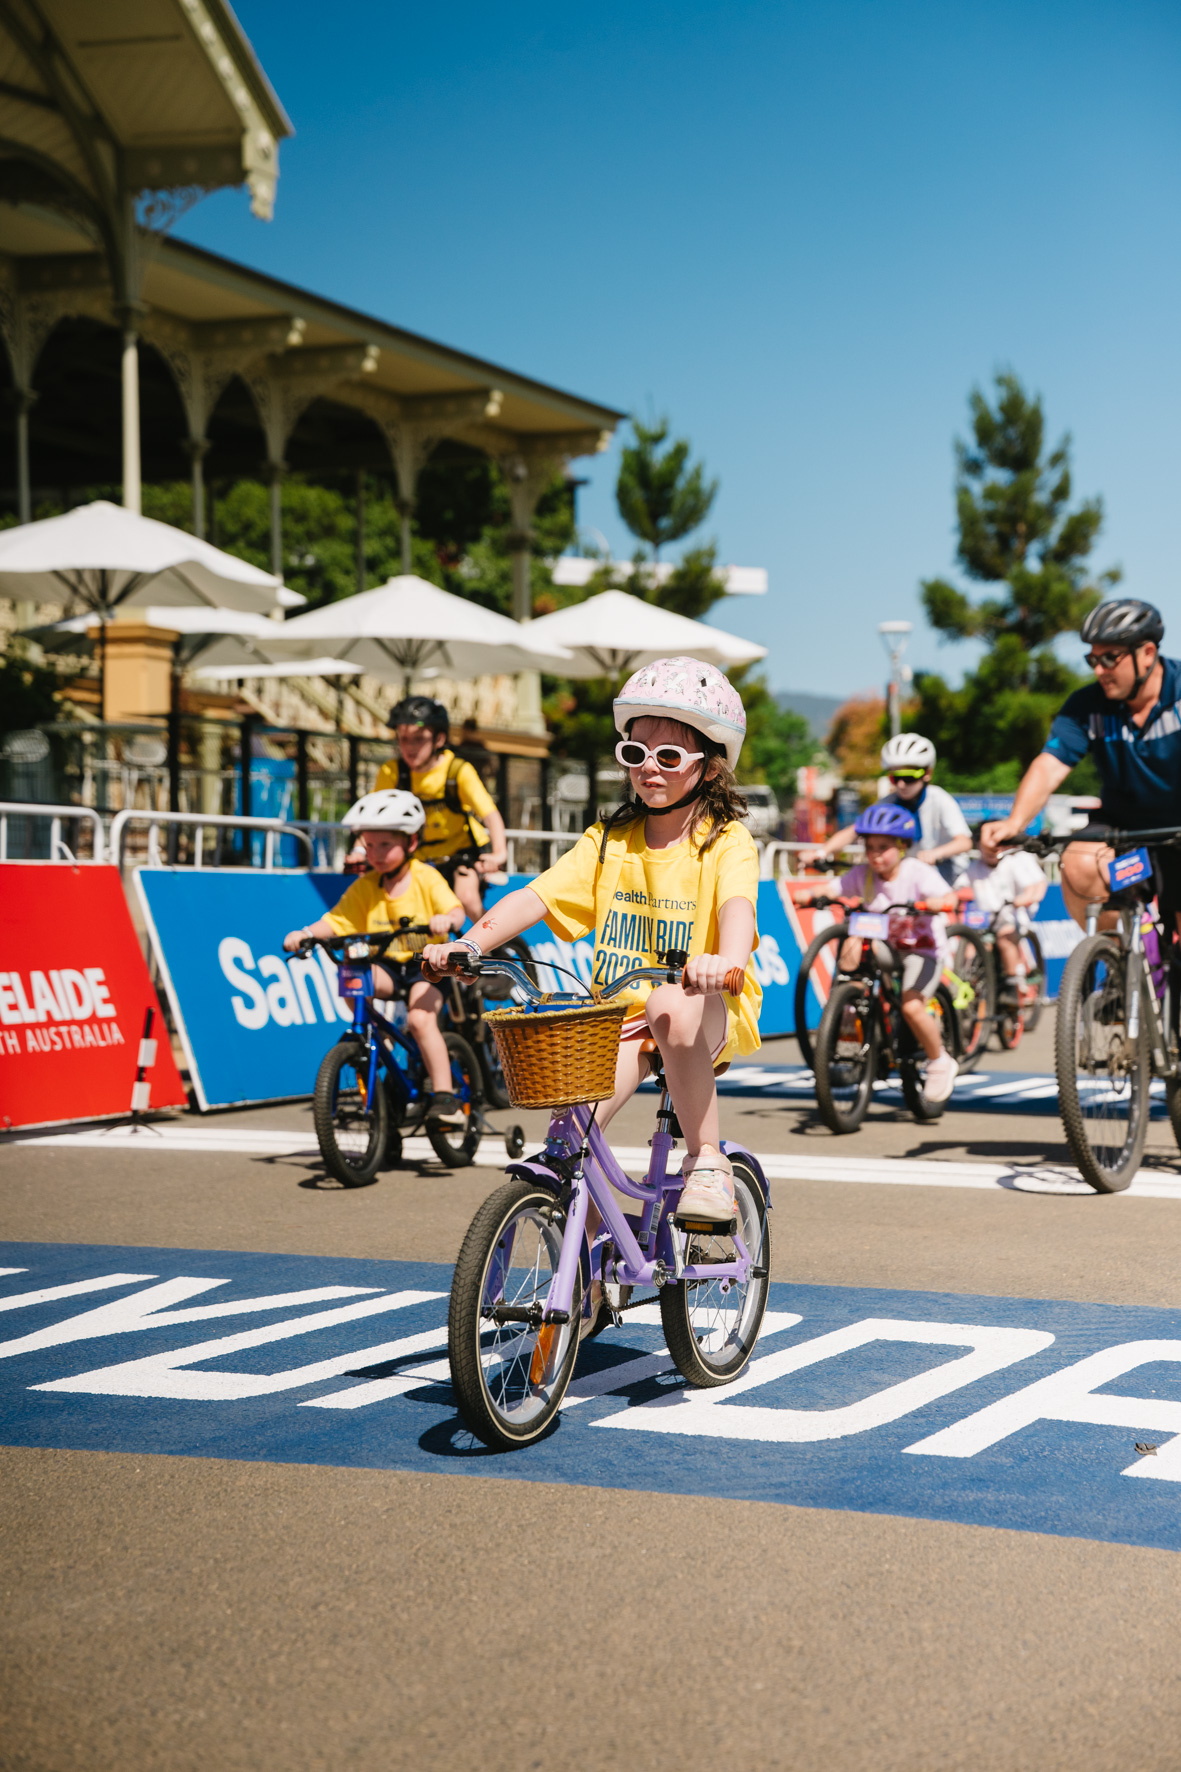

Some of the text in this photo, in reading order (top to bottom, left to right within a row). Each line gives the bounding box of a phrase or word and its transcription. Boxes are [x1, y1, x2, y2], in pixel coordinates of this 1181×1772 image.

[613, 889, 697, 911] ealthPartners
[599, 909, 695, 957] FAMILY RIDE
[0, 967, 117, 1025] ELAIDE
[218, 936, 355, 1031] Sant
[25, 1021, 125, 1053] AUSTRALIA
[0, 1267, 1181, 1481] YUNDA
